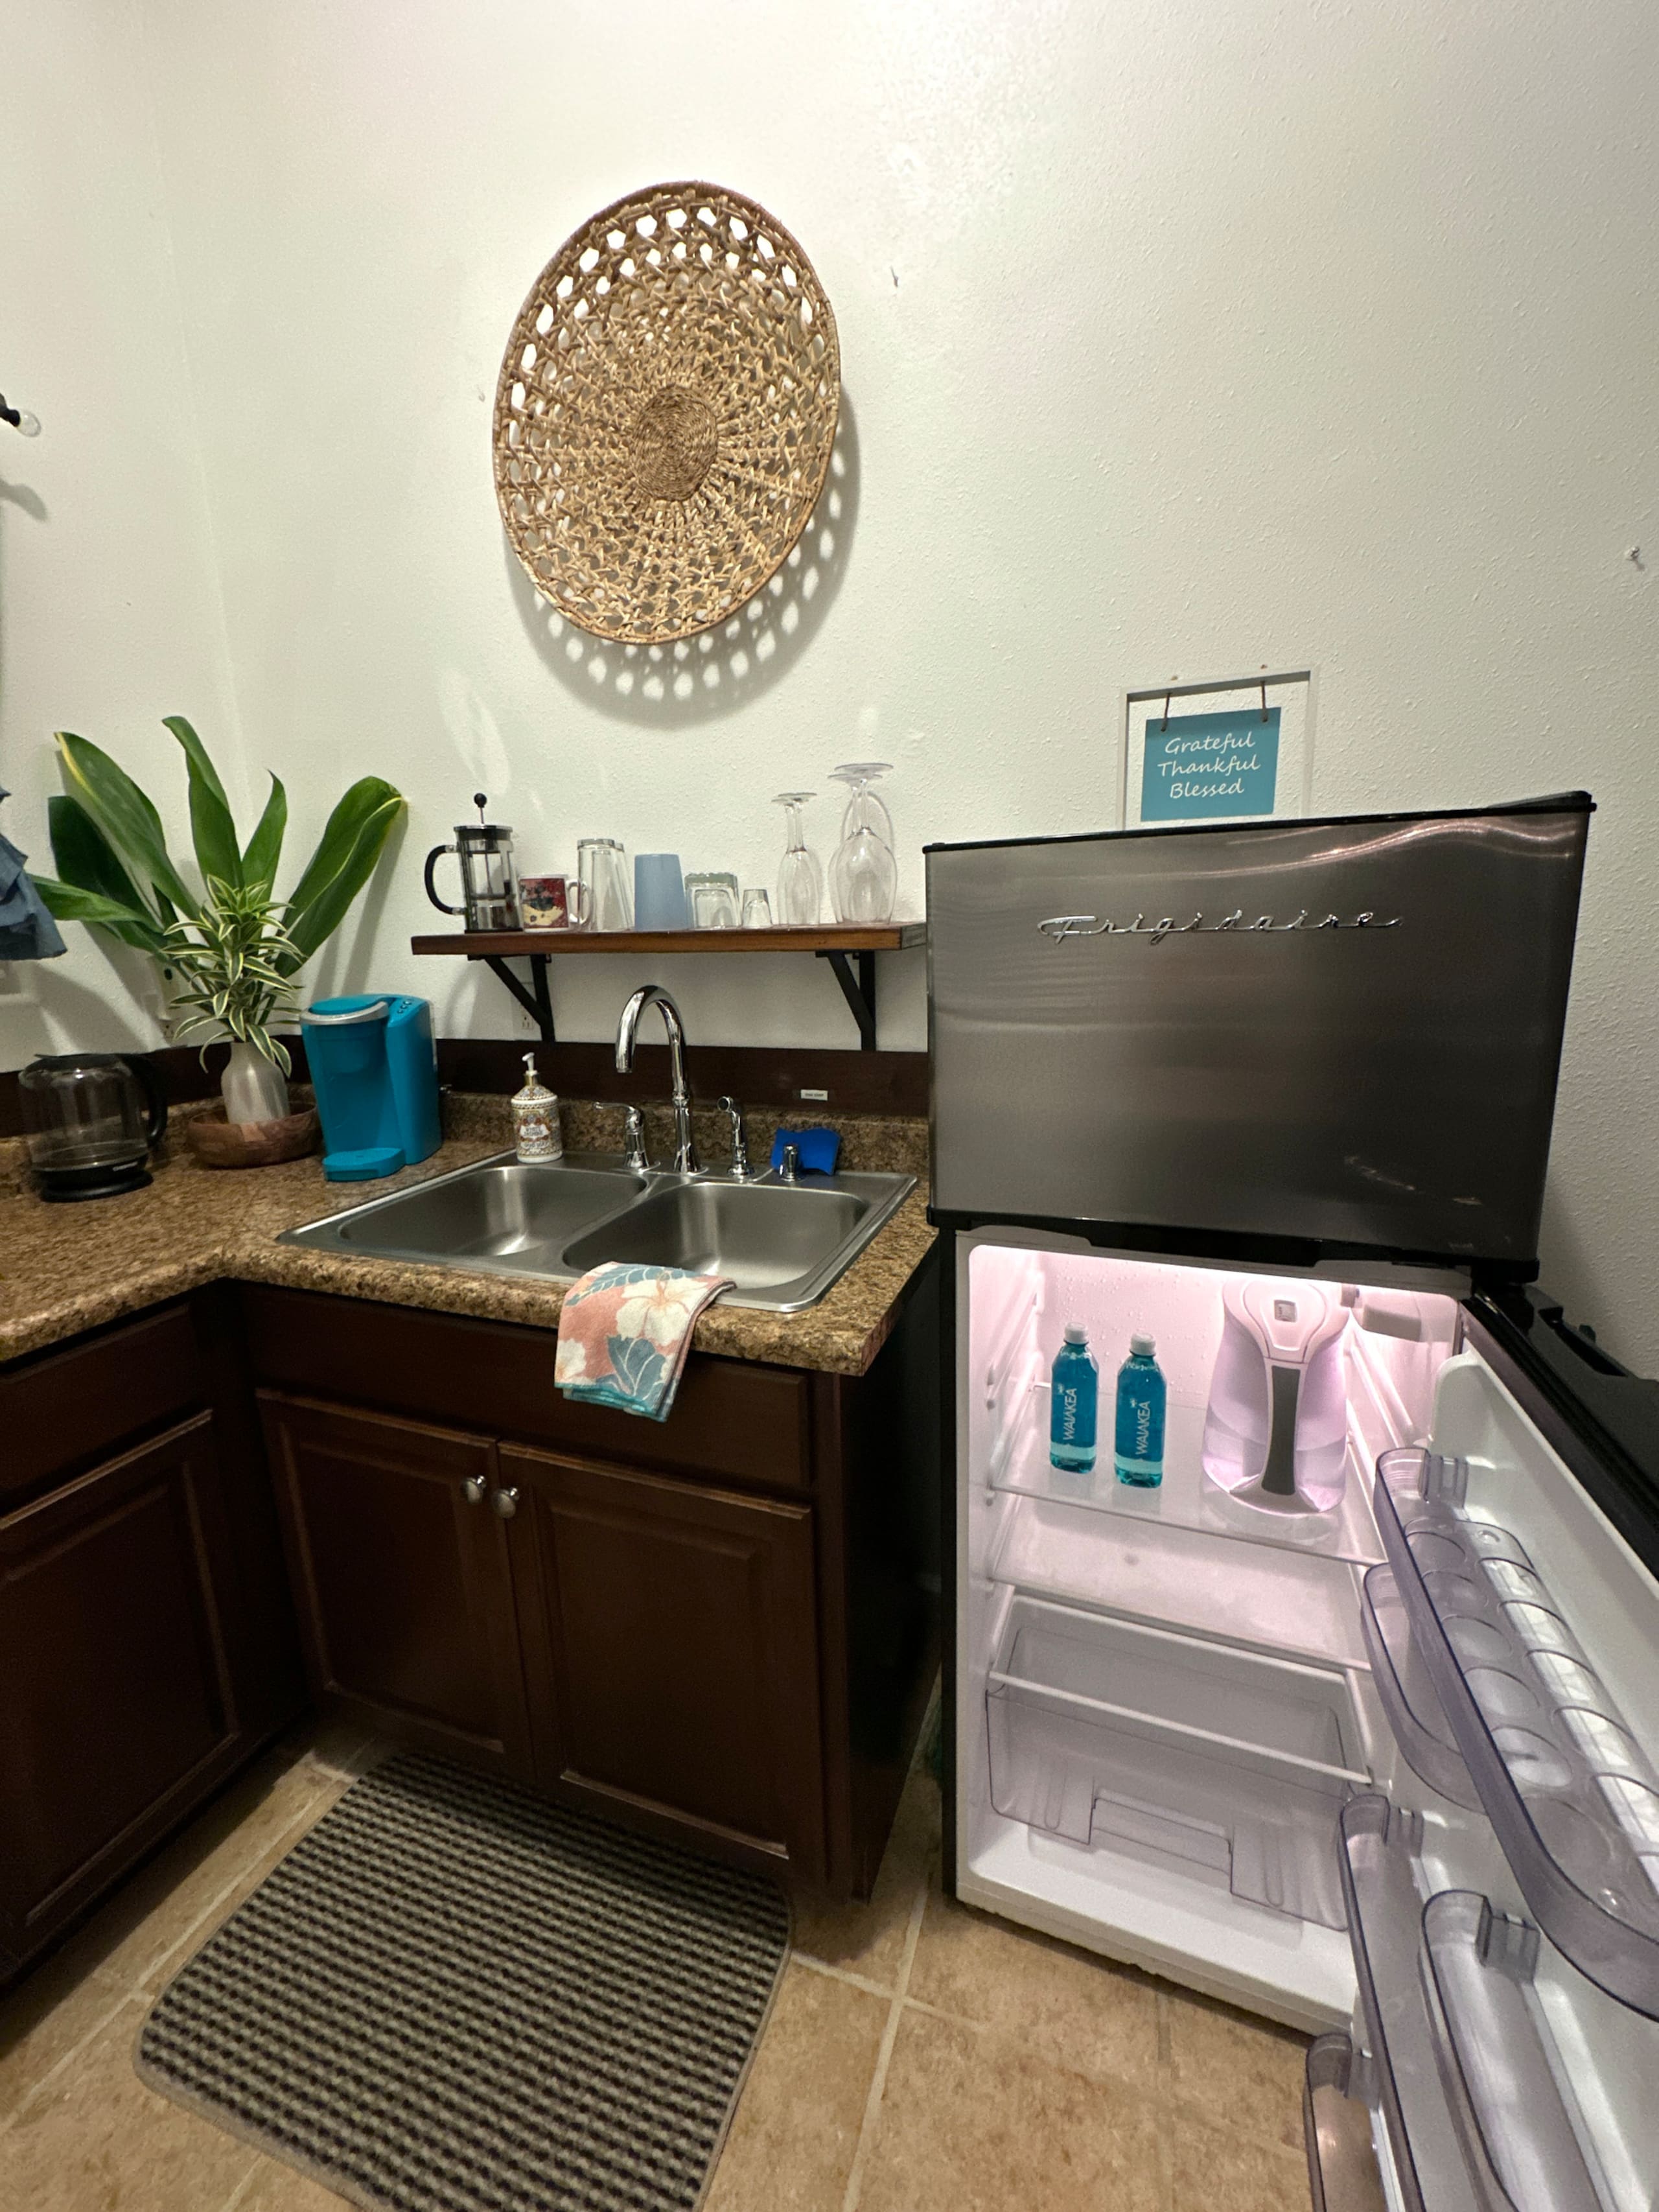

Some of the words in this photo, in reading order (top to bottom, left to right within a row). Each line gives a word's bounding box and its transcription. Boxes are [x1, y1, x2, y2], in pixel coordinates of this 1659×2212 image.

[1165, 731, 1256, 754] Grateful
[1157, 754, 1261, 776] Thankful
[1170, 778, 1244, 799] Blessed
[1037, 909, 1404, 946] Frigidaire
[1063, 1388, 1077, 1441] WAIAKEA
[1135, 1401, 1151, 1456] WAIAKEA
